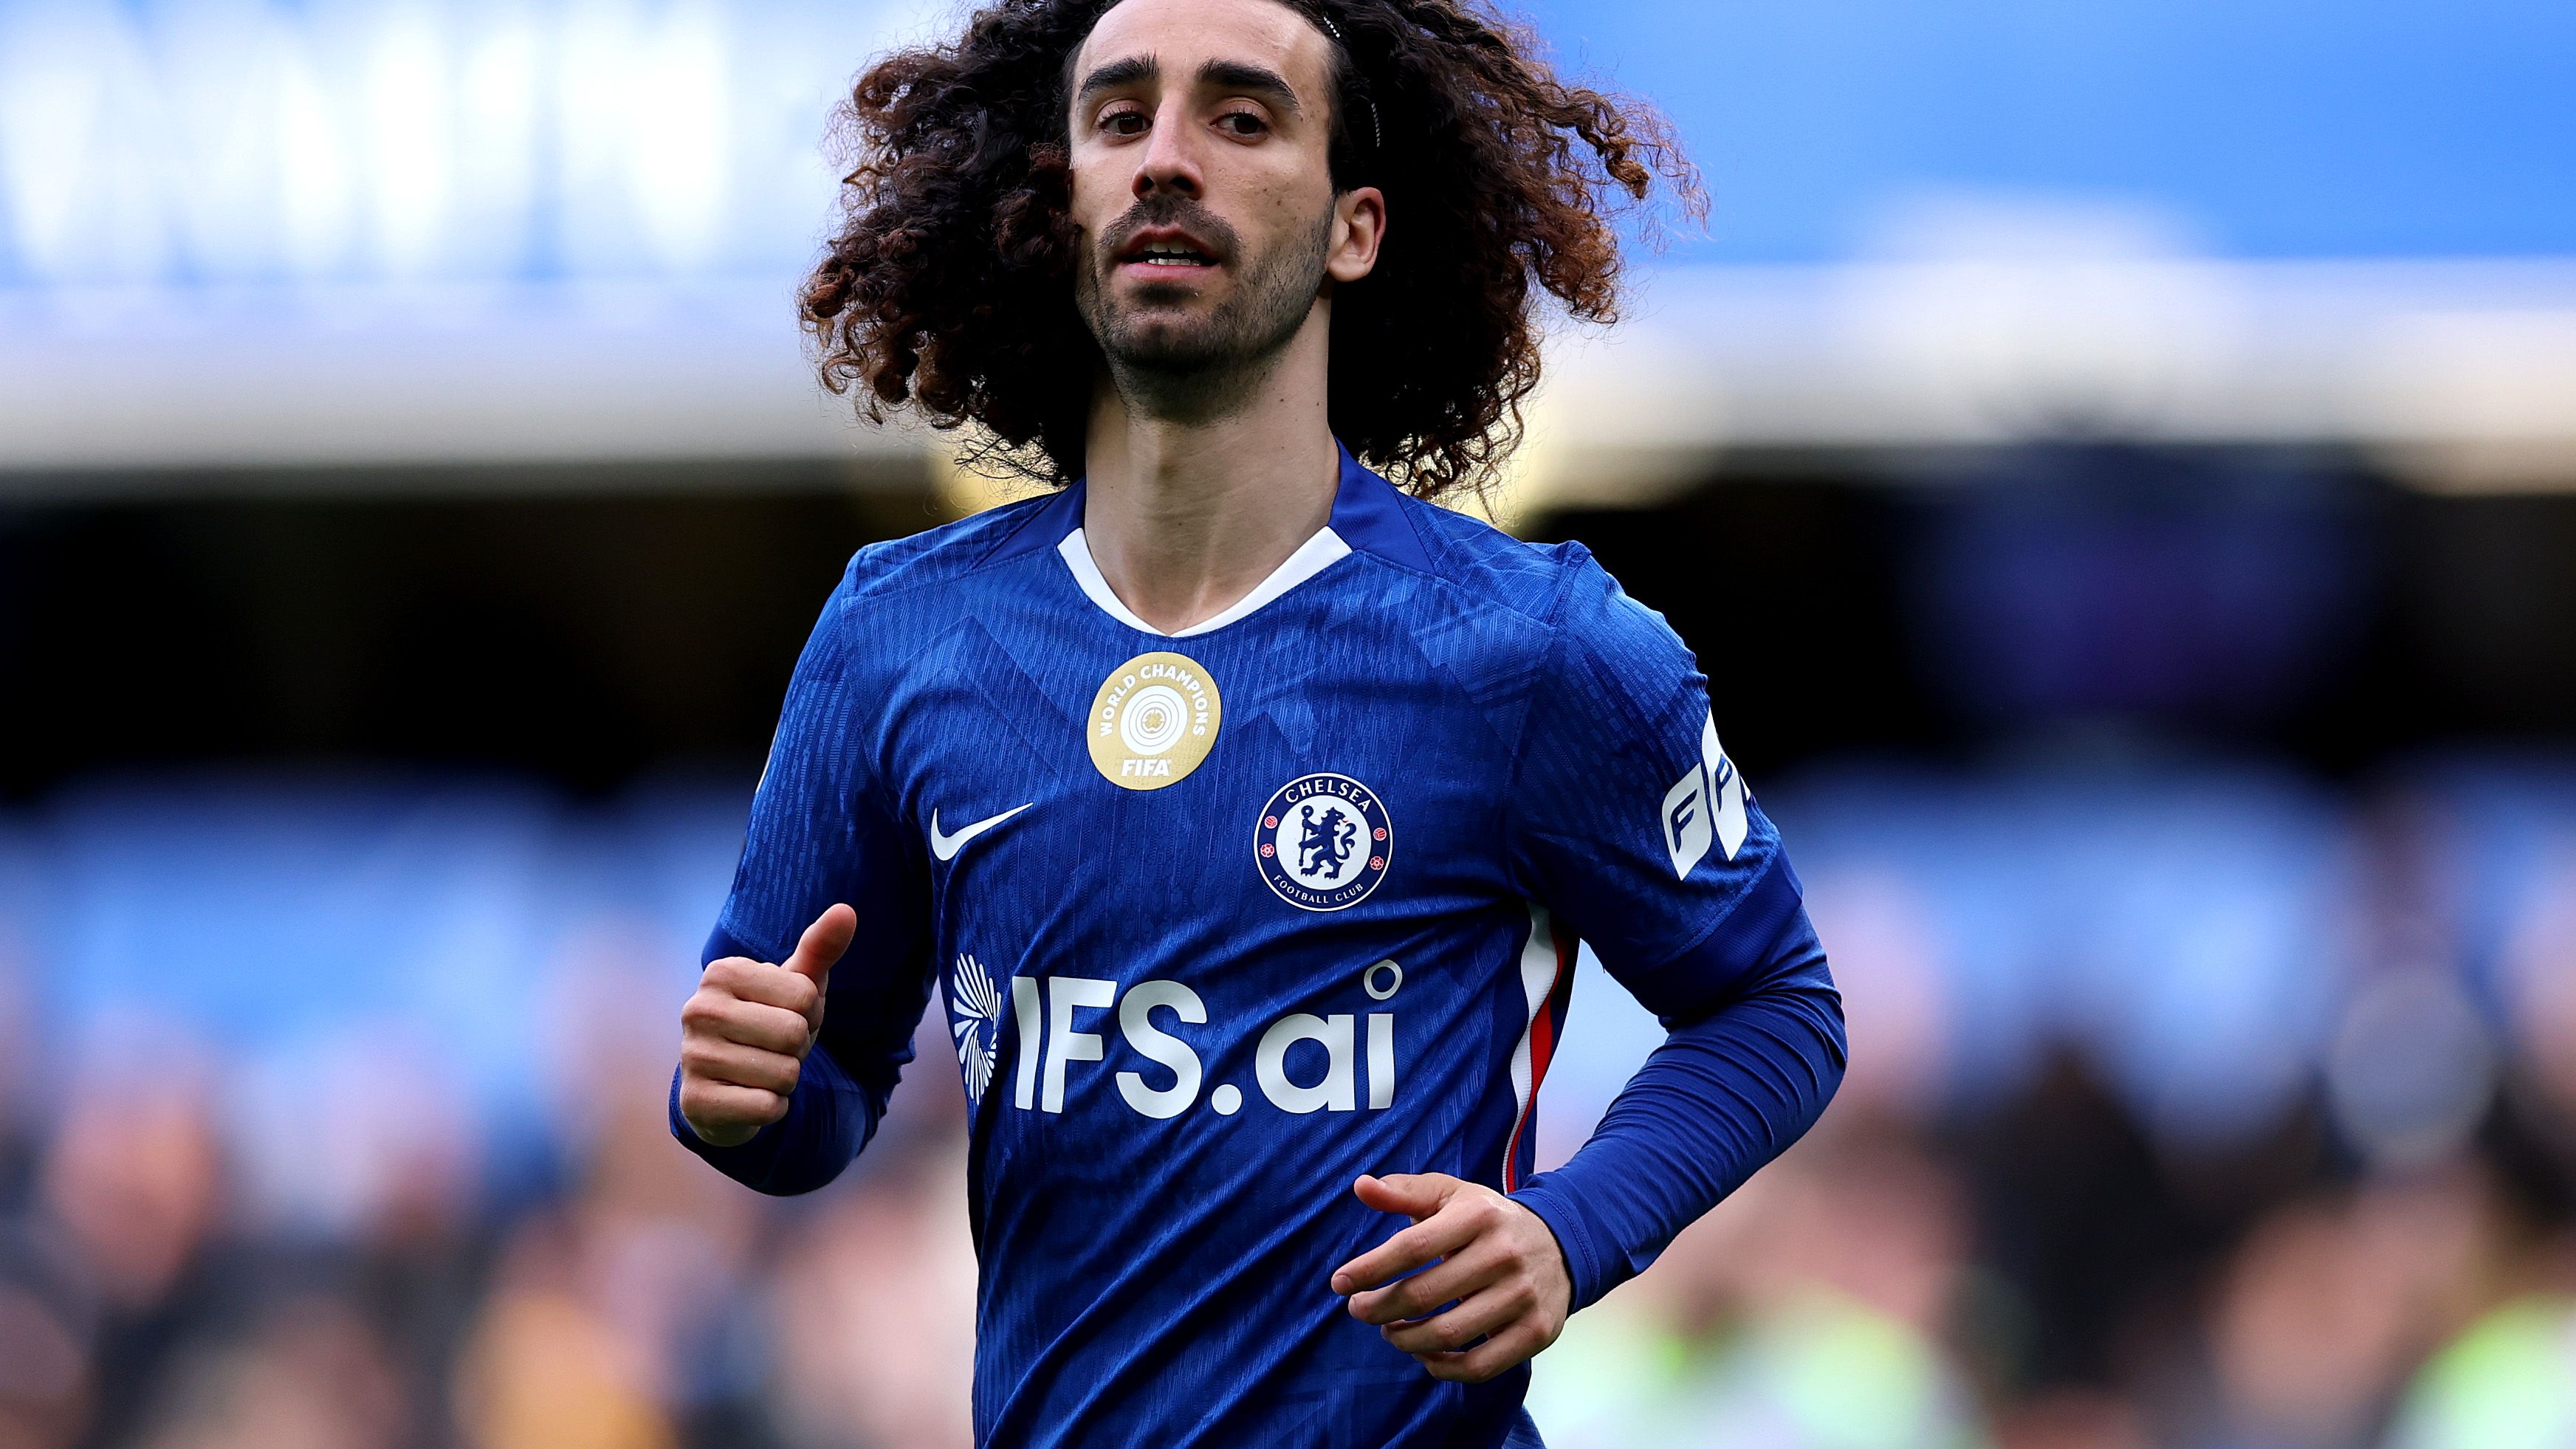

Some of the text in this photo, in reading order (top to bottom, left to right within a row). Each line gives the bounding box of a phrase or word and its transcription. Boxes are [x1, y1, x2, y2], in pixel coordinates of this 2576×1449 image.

[1100, 664, 1209, 737] WORLD CHAMPIONS
[1121, 759, 1170, 777] FIFA
[1285, 779, 1372, 813] CHELSEA
[1274, 874, 1364, 904] FOOTBALL CLUB
[1012, 959, 1403, 1120] IFS.ai
